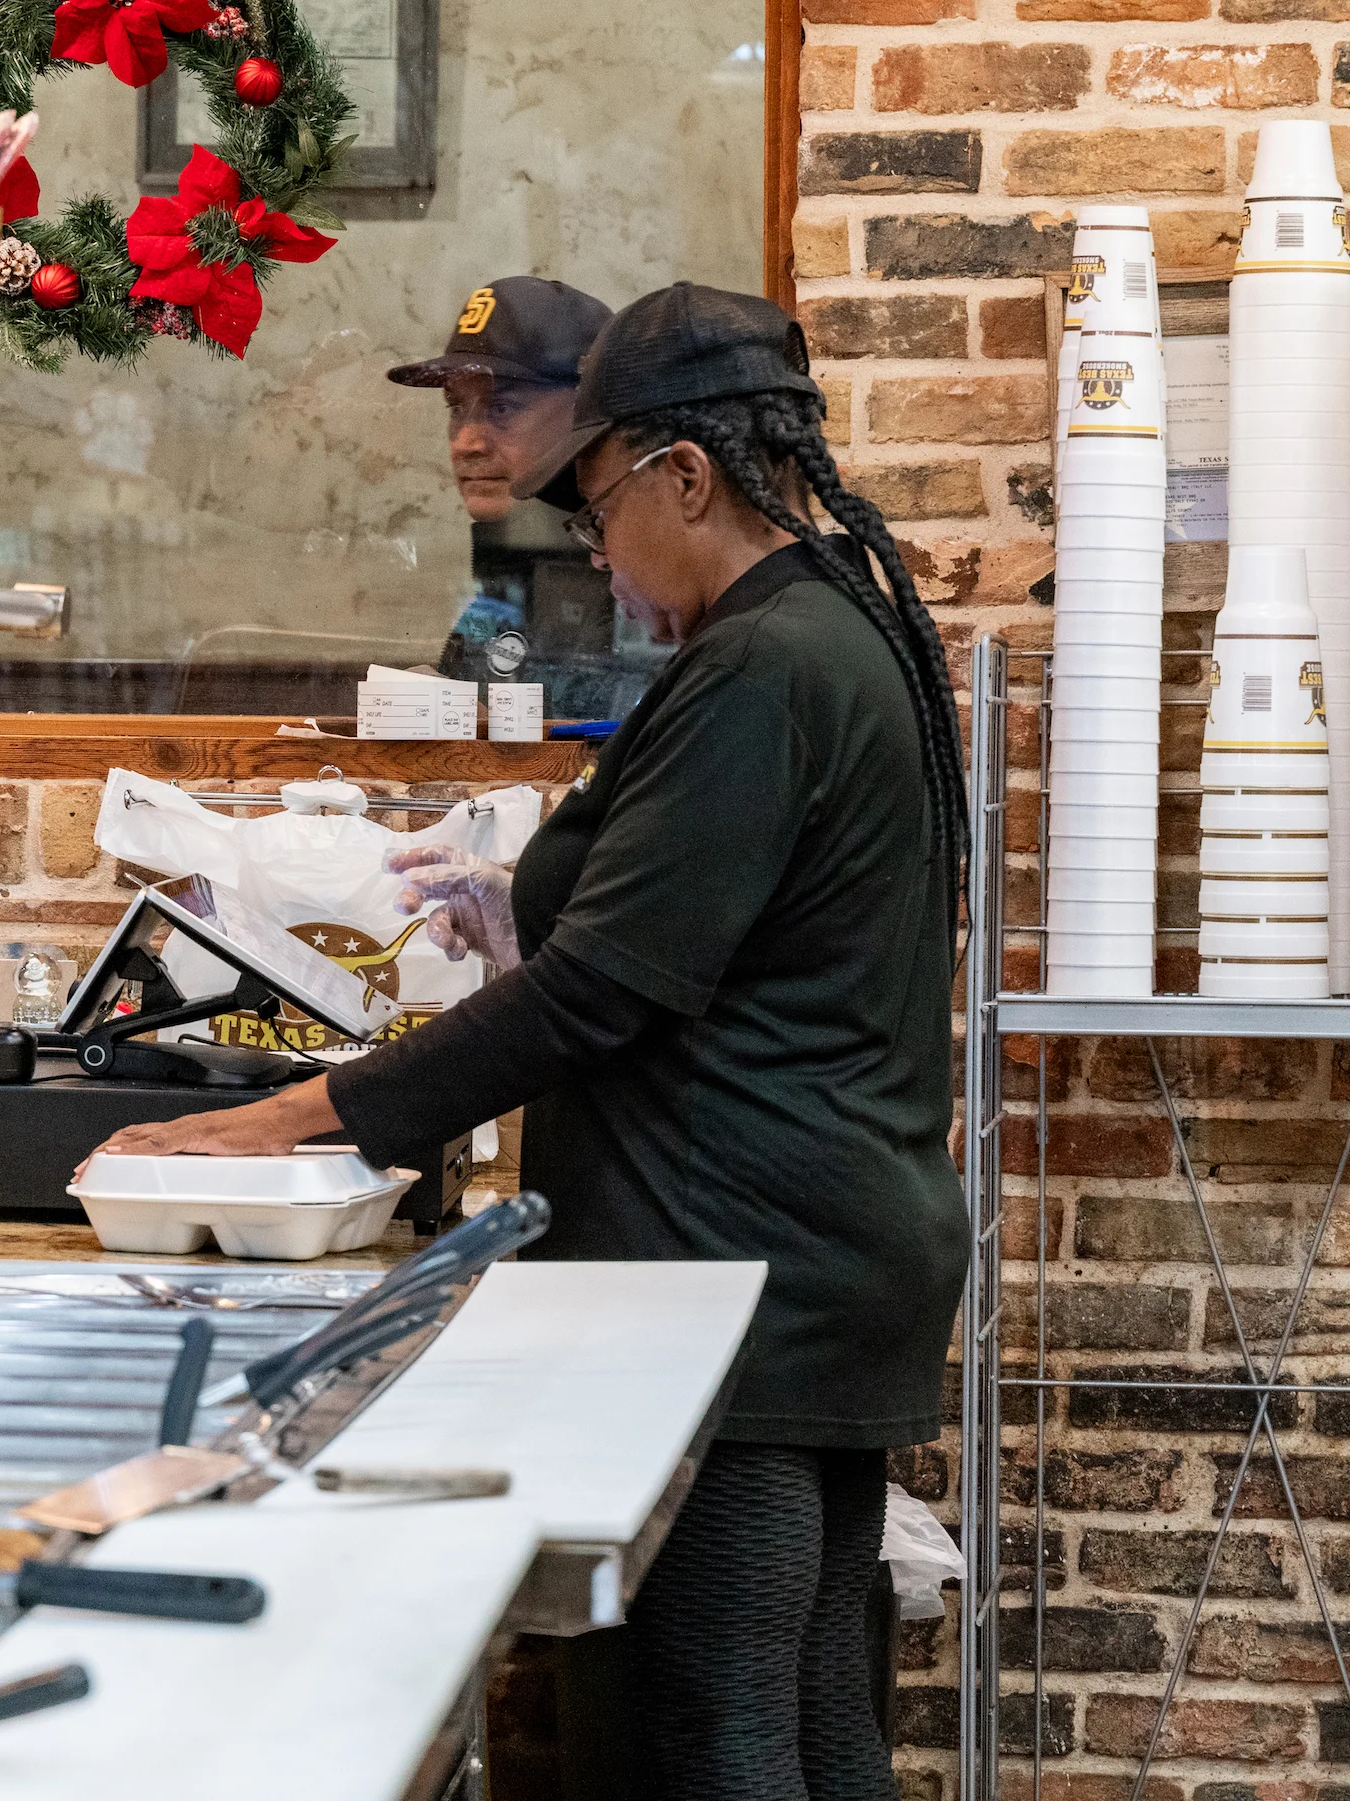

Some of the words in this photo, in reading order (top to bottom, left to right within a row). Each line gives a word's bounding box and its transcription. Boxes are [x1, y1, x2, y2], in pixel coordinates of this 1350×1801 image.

[1078, 262, 1104, 272] TEXAS
[1078, 369, 1097, 379] BEST
[1100, 369, 1133, 379] TEXAS
[215, 1014, 326, 1052] TEXAS
